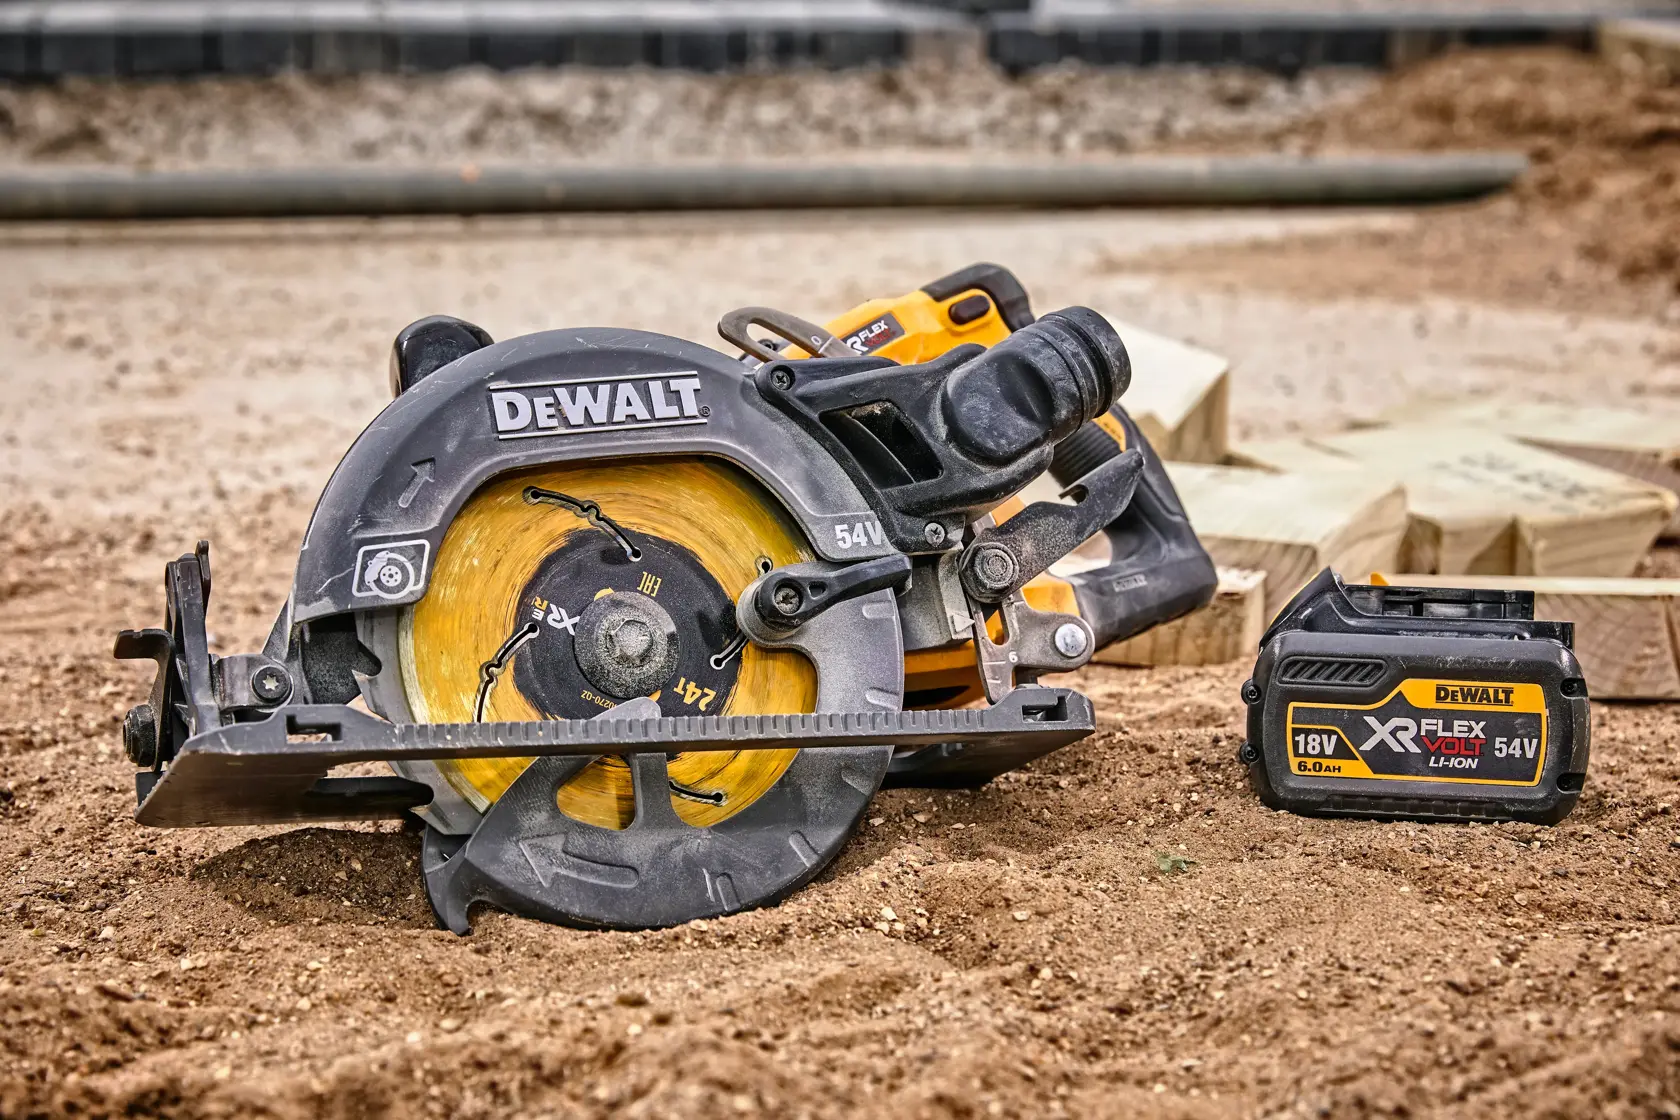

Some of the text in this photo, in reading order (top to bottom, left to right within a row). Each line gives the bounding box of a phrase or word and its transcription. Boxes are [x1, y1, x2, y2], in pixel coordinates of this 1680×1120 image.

[858, 319, 889, 342] FLEX
[491, 377, 701, 433] DEWALT
[834, 520, 882, 549] 54V
[546, 603, 581, 636] XR
[1008, 651, 1019, 663] 6
[673, 677, 717, 712] 24T
[1435, 685, 1514, 706] DEWALT
[1294, 733, 1338, 756] 18V
[1358, 715, 1488, 754] XR FLEX
[1420, 737, 1487, 757] VOLT
[1493, 736, 1539, 759] 54V
[1296, 760, 1342, 774] 6.0AH
[1428, 756, 1479, 770] LI-ION
